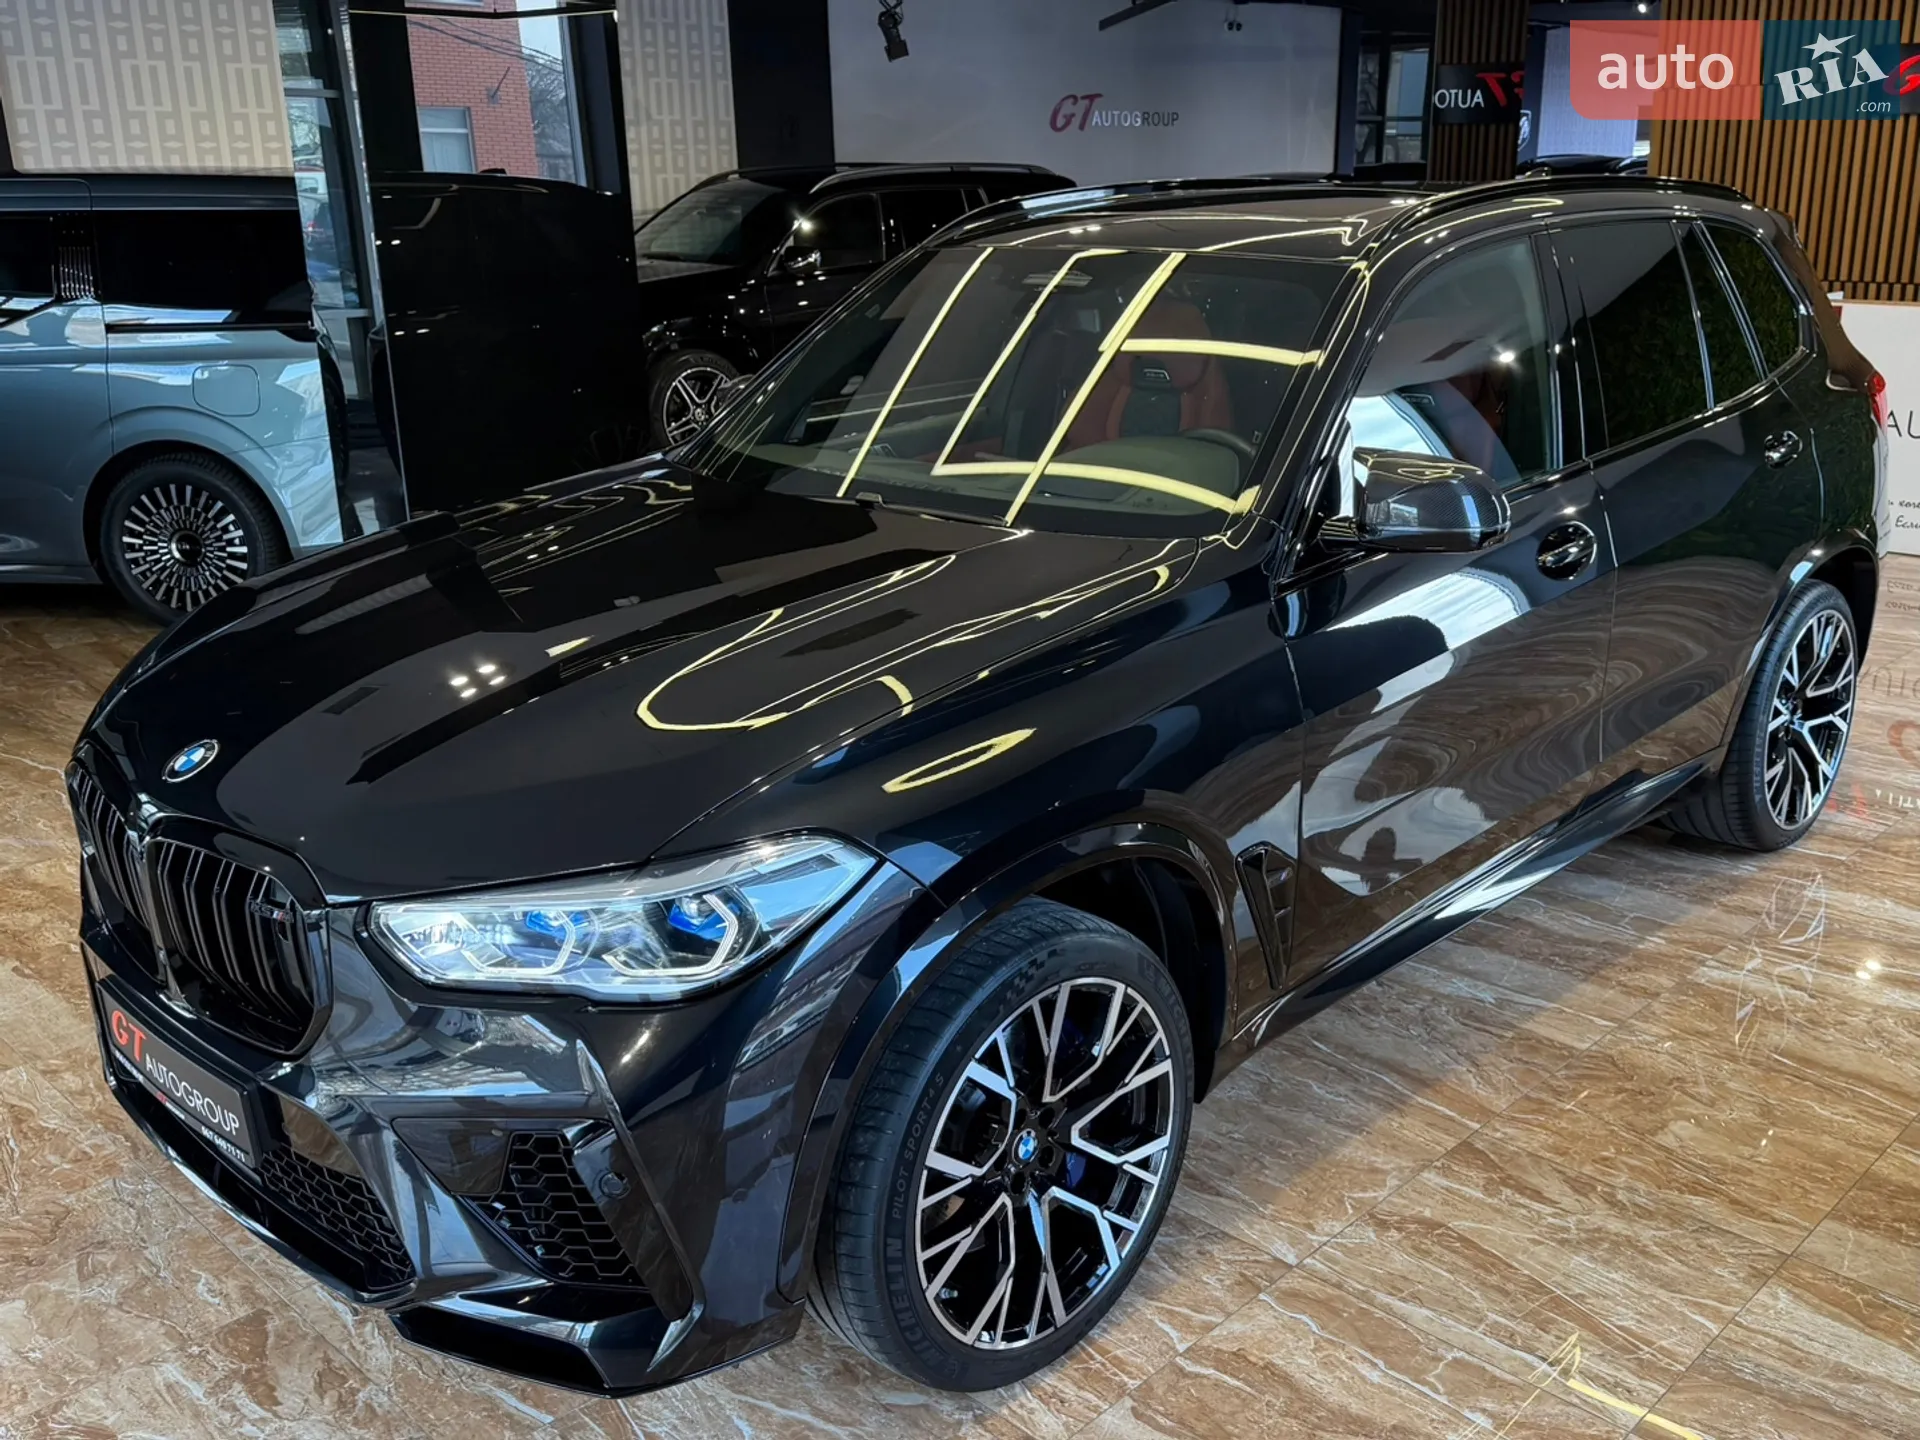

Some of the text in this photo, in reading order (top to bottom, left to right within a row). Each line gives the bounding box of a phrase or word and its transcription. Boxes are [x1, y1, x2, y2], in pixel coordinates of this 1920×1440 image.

[1050, 93, 1180, 133] GT AUTOGROUP
[111, 1010, 147, 1062] GT
[145, 1053, 240, 1136] AUTOGROUP
[892, 1167, 909, 1219] PILOT
[904, 1097, 932, 1161] SPORT
[886, 1237, 946, 1369] MICHELIN
